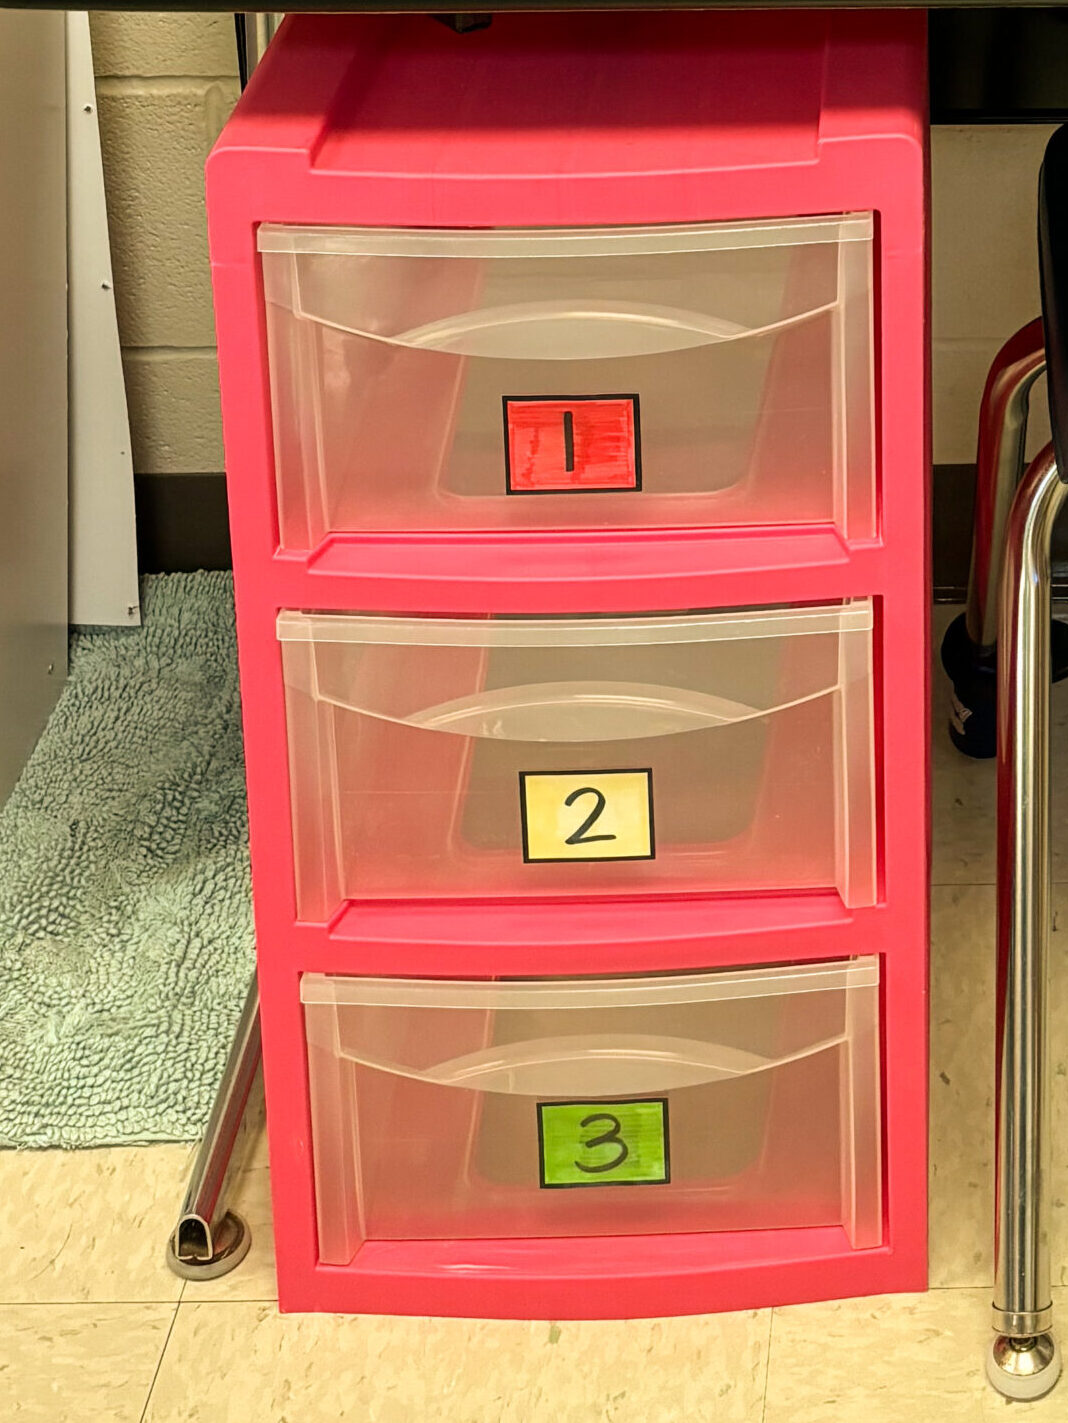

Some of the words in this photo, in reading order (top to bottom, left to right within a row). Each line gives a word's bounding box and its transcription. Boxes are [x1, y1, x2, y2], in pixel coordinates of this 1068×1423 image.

[563, 410, 575, 474] 1
[564, 786, 618, 846] 2
[573, 1112, 630, 1174] 3
